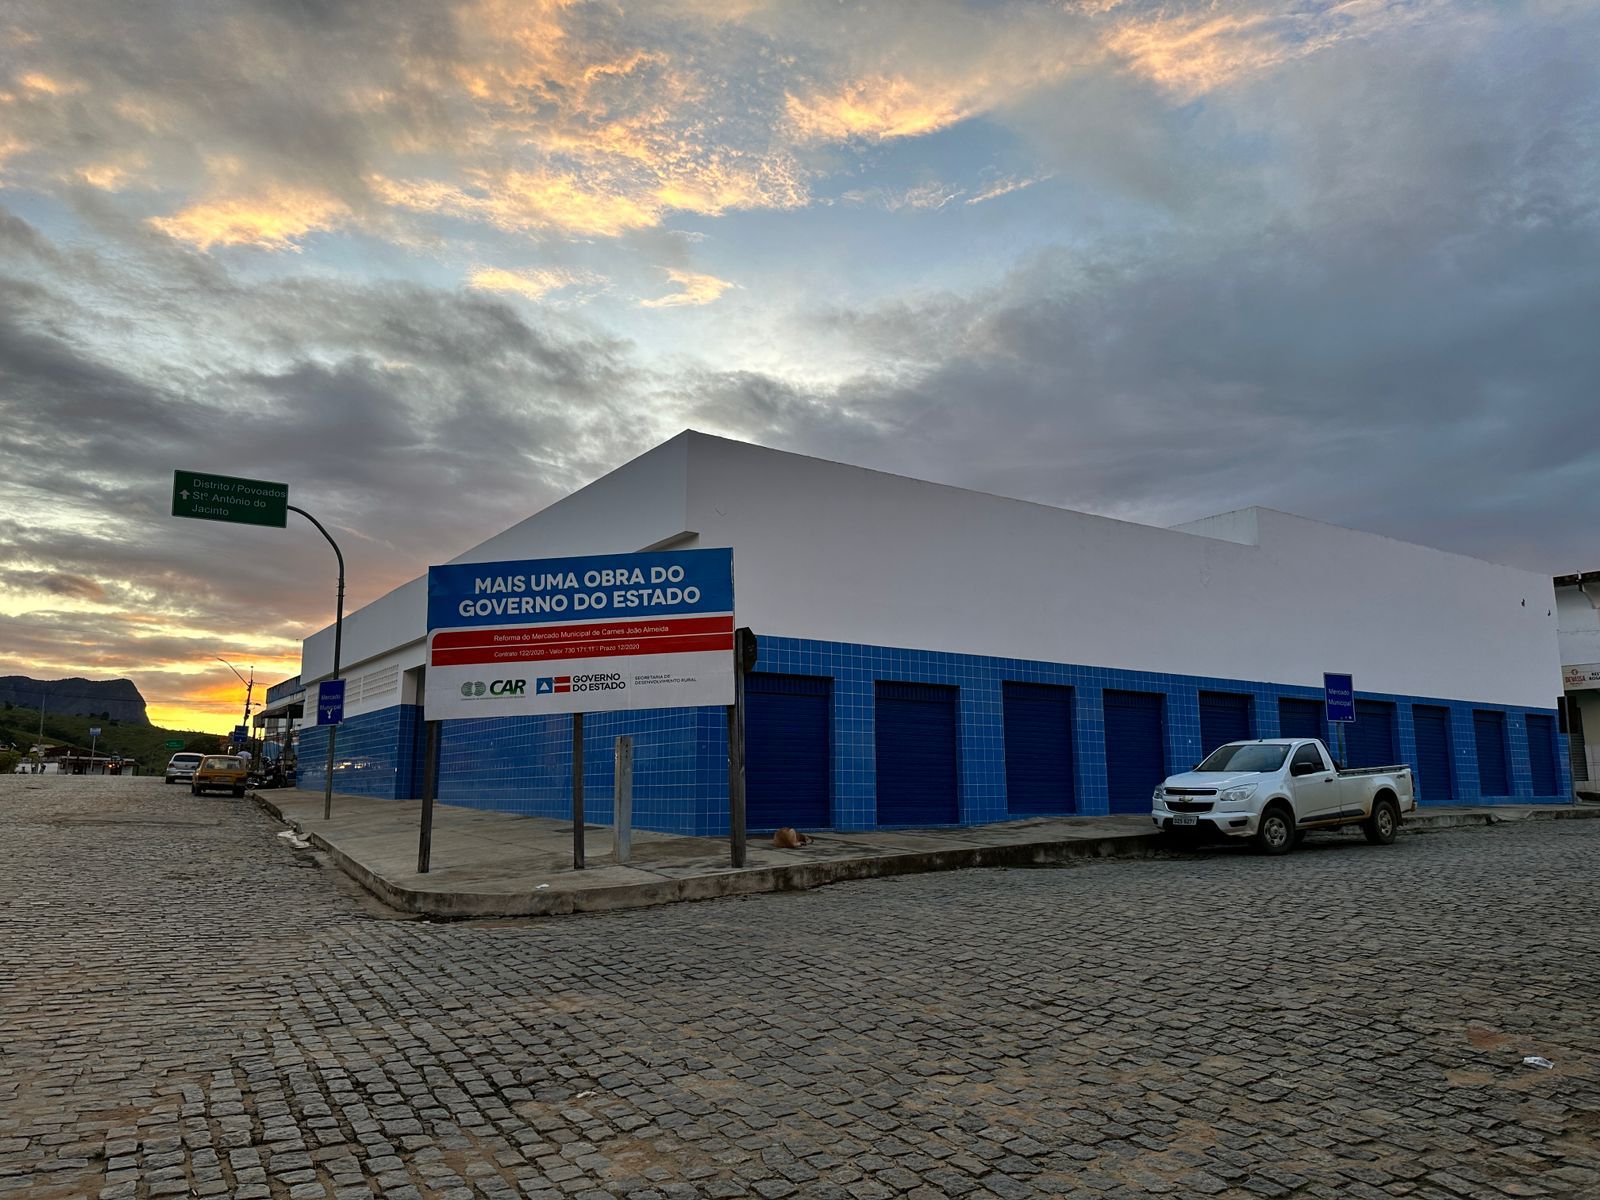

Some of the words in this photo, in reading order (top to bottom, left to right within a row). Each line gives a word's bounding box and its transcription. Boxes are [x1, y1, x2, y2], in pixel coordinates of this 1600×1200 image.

[193, 479, 230, 491] Distrito
[237, 484, 286, 498] Povoados
[212, 494, 251, 506] Antônio
[253, 499, 267, 508] do
[192, 504, 229, 516] Jacinto
[474, 575, 526, 594] MAIS
[530, 572, 580, 591] UMA
[584, 567, 645, 588] OBRA
[650, 565, 685, 584] DO
[458, 594, 568, 617] GOVERNO
[574, 591, 607, 610] DO
[613, 586, 700, 609] ESTADO
[493, 634, 521, 642] Reforma
[531, 632, 560, 640] Mercado
[560, 630, 591, 638] Municipal
[572, 672, 621, 683] GOVERNO
[489, 679, 527, 696] CAR
[572, 683, 588, 692] DO
[588, 681, 626, 691] ESTADO
